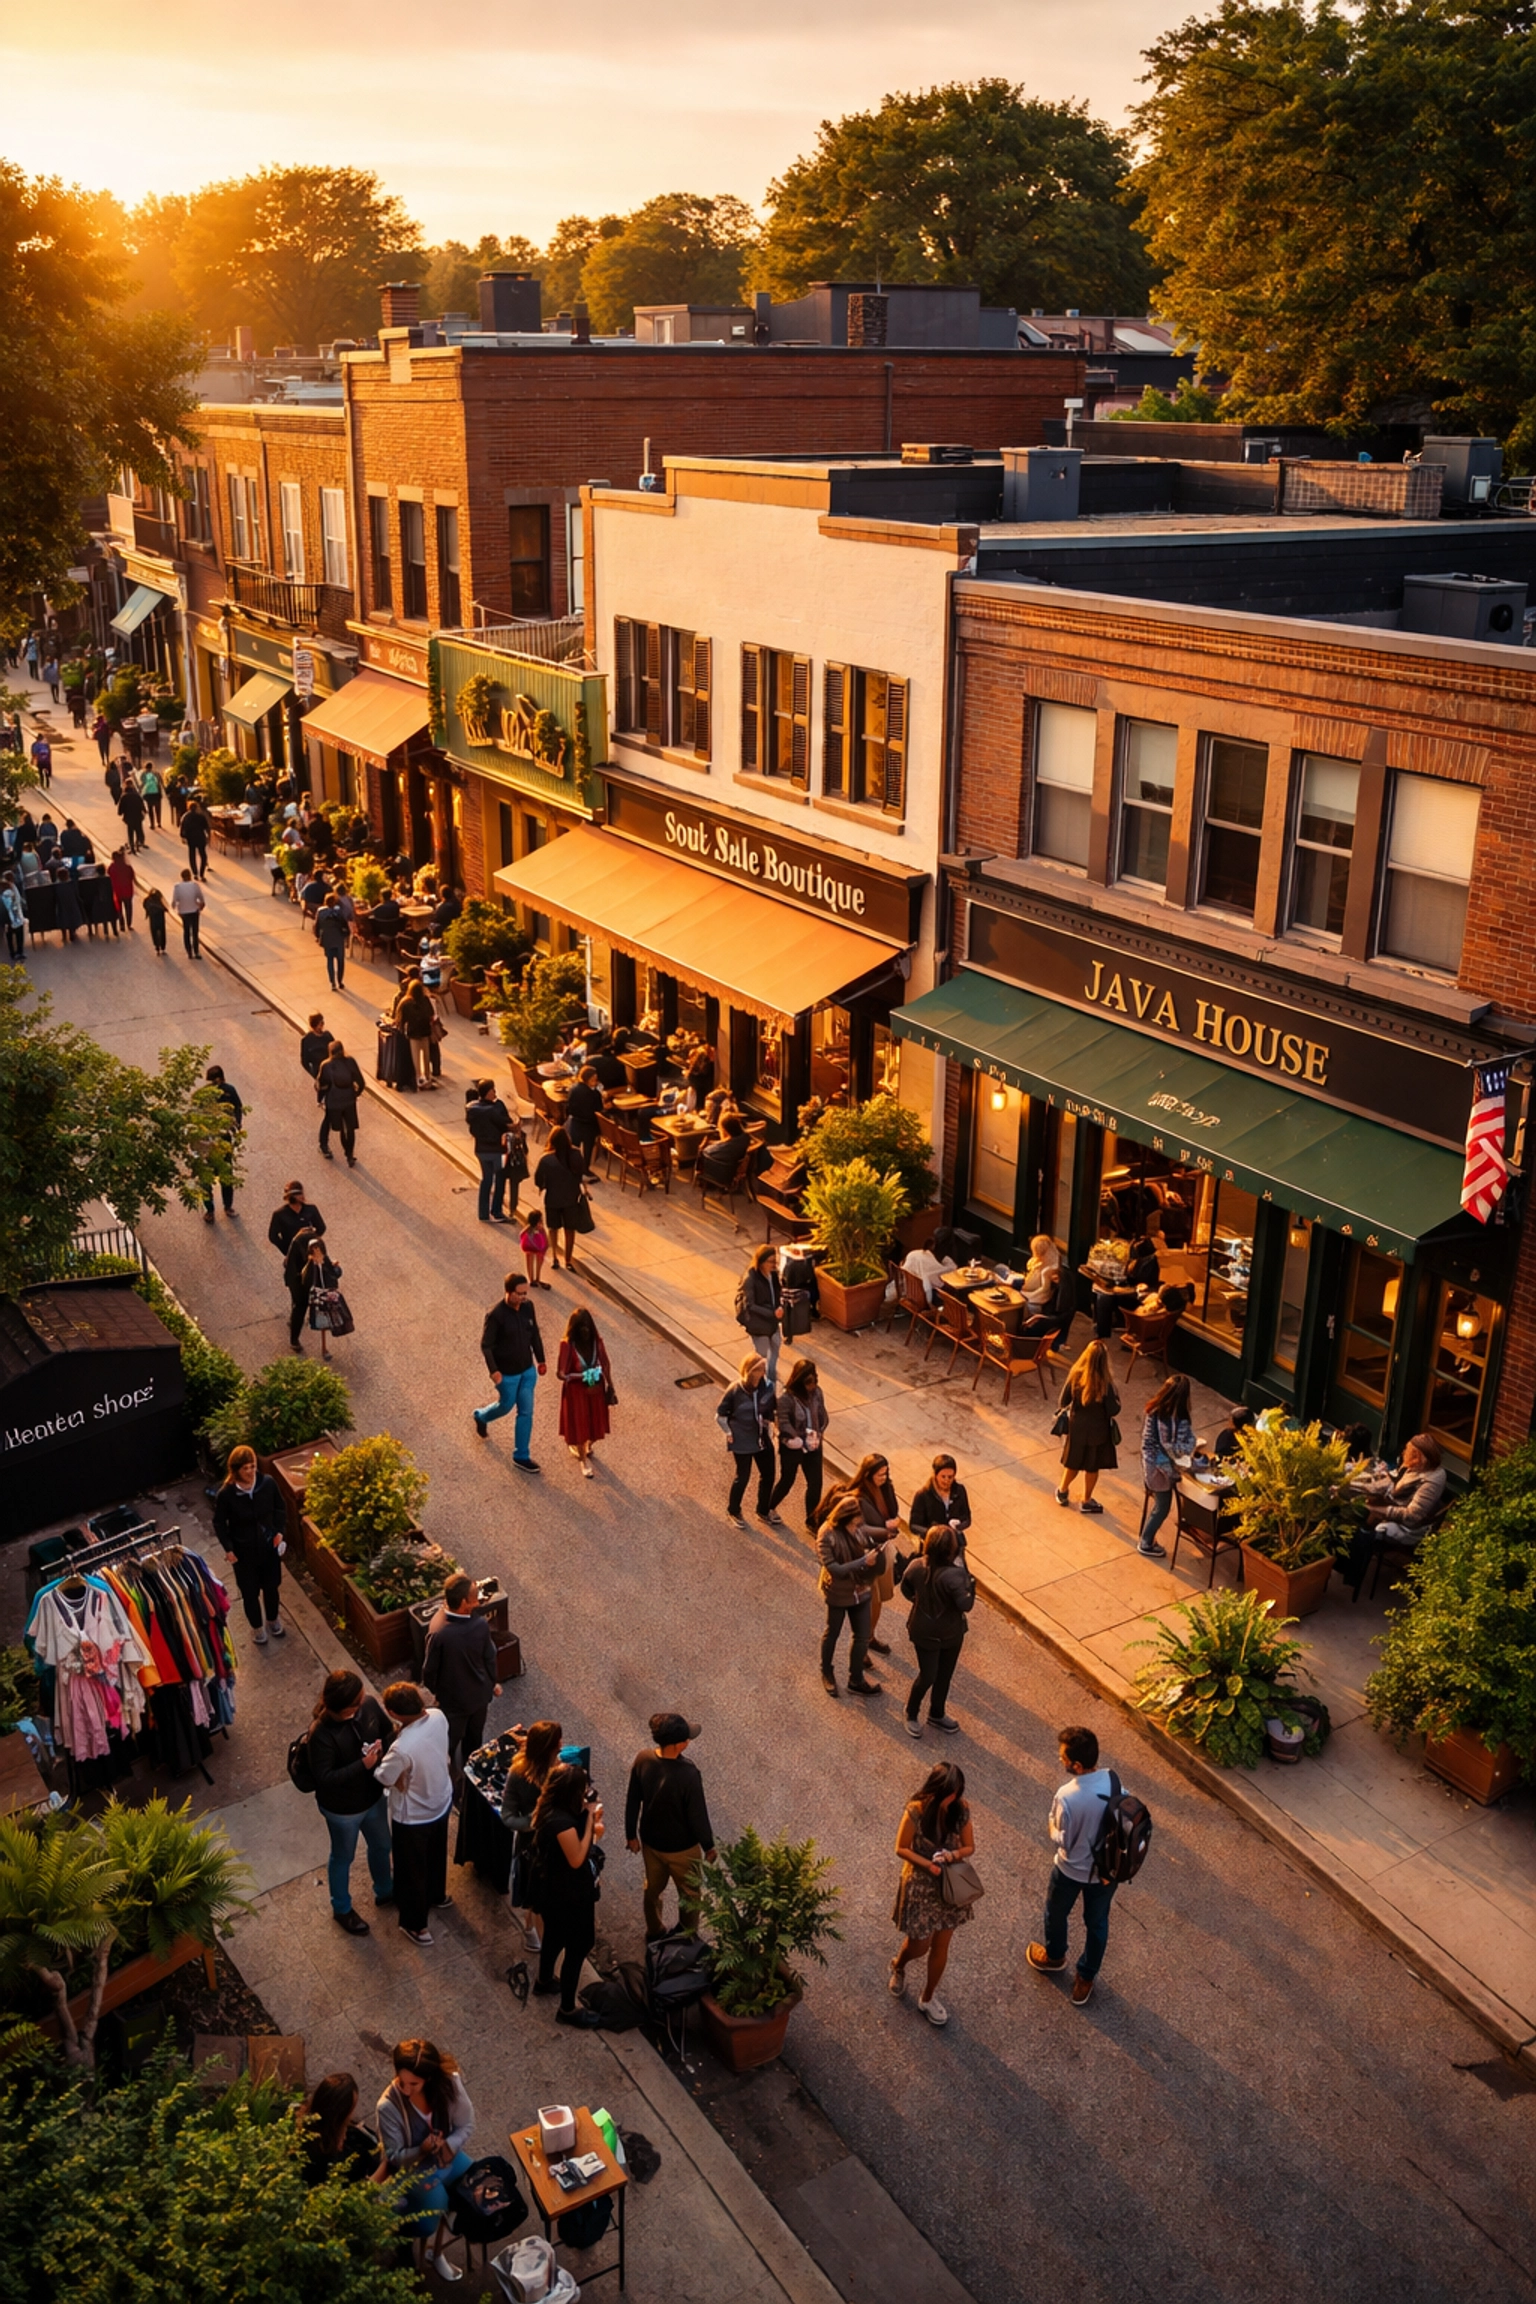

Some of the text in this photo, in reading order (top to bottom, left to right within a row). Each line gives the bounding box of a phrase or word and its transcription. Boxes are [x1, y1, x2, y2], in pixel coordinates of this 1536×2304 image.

[762, 844, 865, 915] Boutique
[1084, 960, 1330, 1086] JAVA HOUSE
